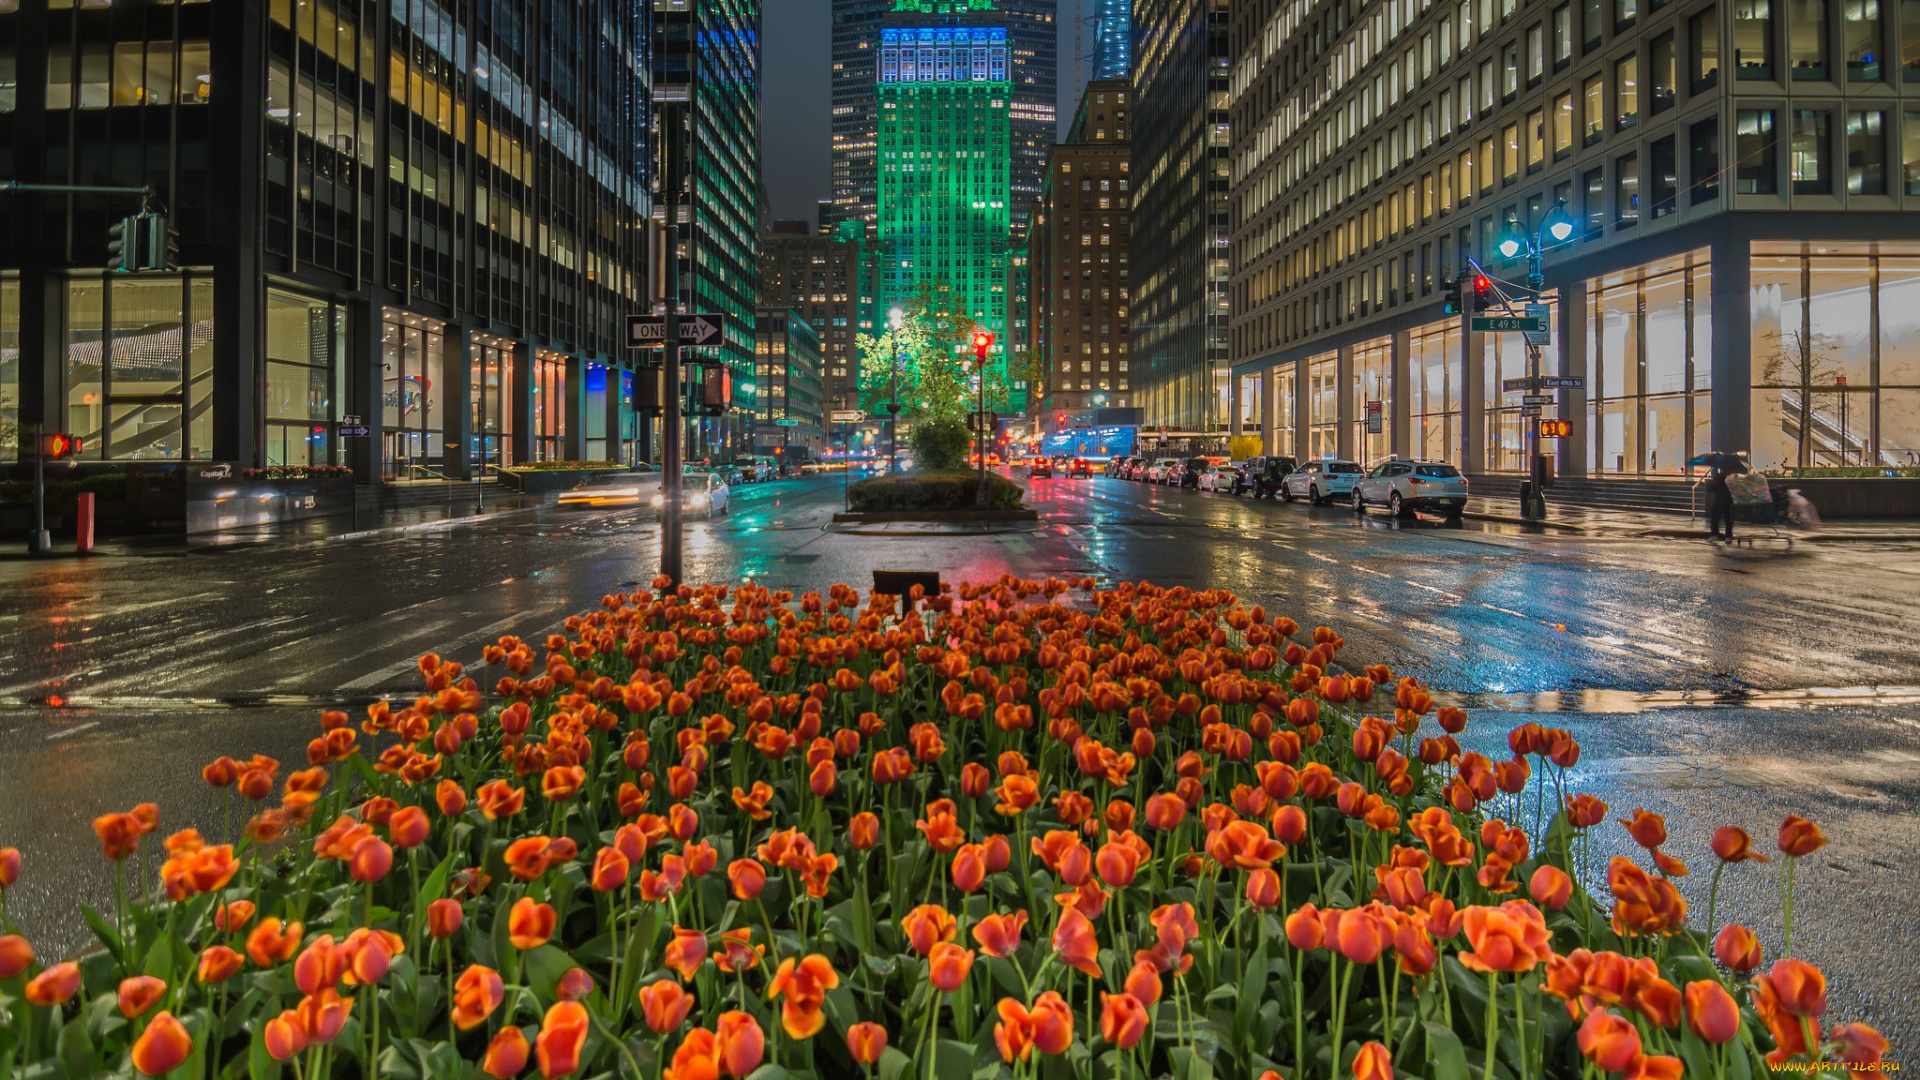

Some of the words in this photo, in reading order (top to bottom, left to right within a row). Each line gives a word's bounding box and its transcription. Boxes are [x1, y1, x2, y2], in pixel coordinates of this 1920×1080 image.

[641, 325, 665, 337] ONE
[680, 324, 708, 337] WAY
[1490, 320, 1495, 328] E
[1498, 320, 1509, 329] 49
[1511, 320, 1521, 329] St
[1539, 321, 1548, 333] 5
